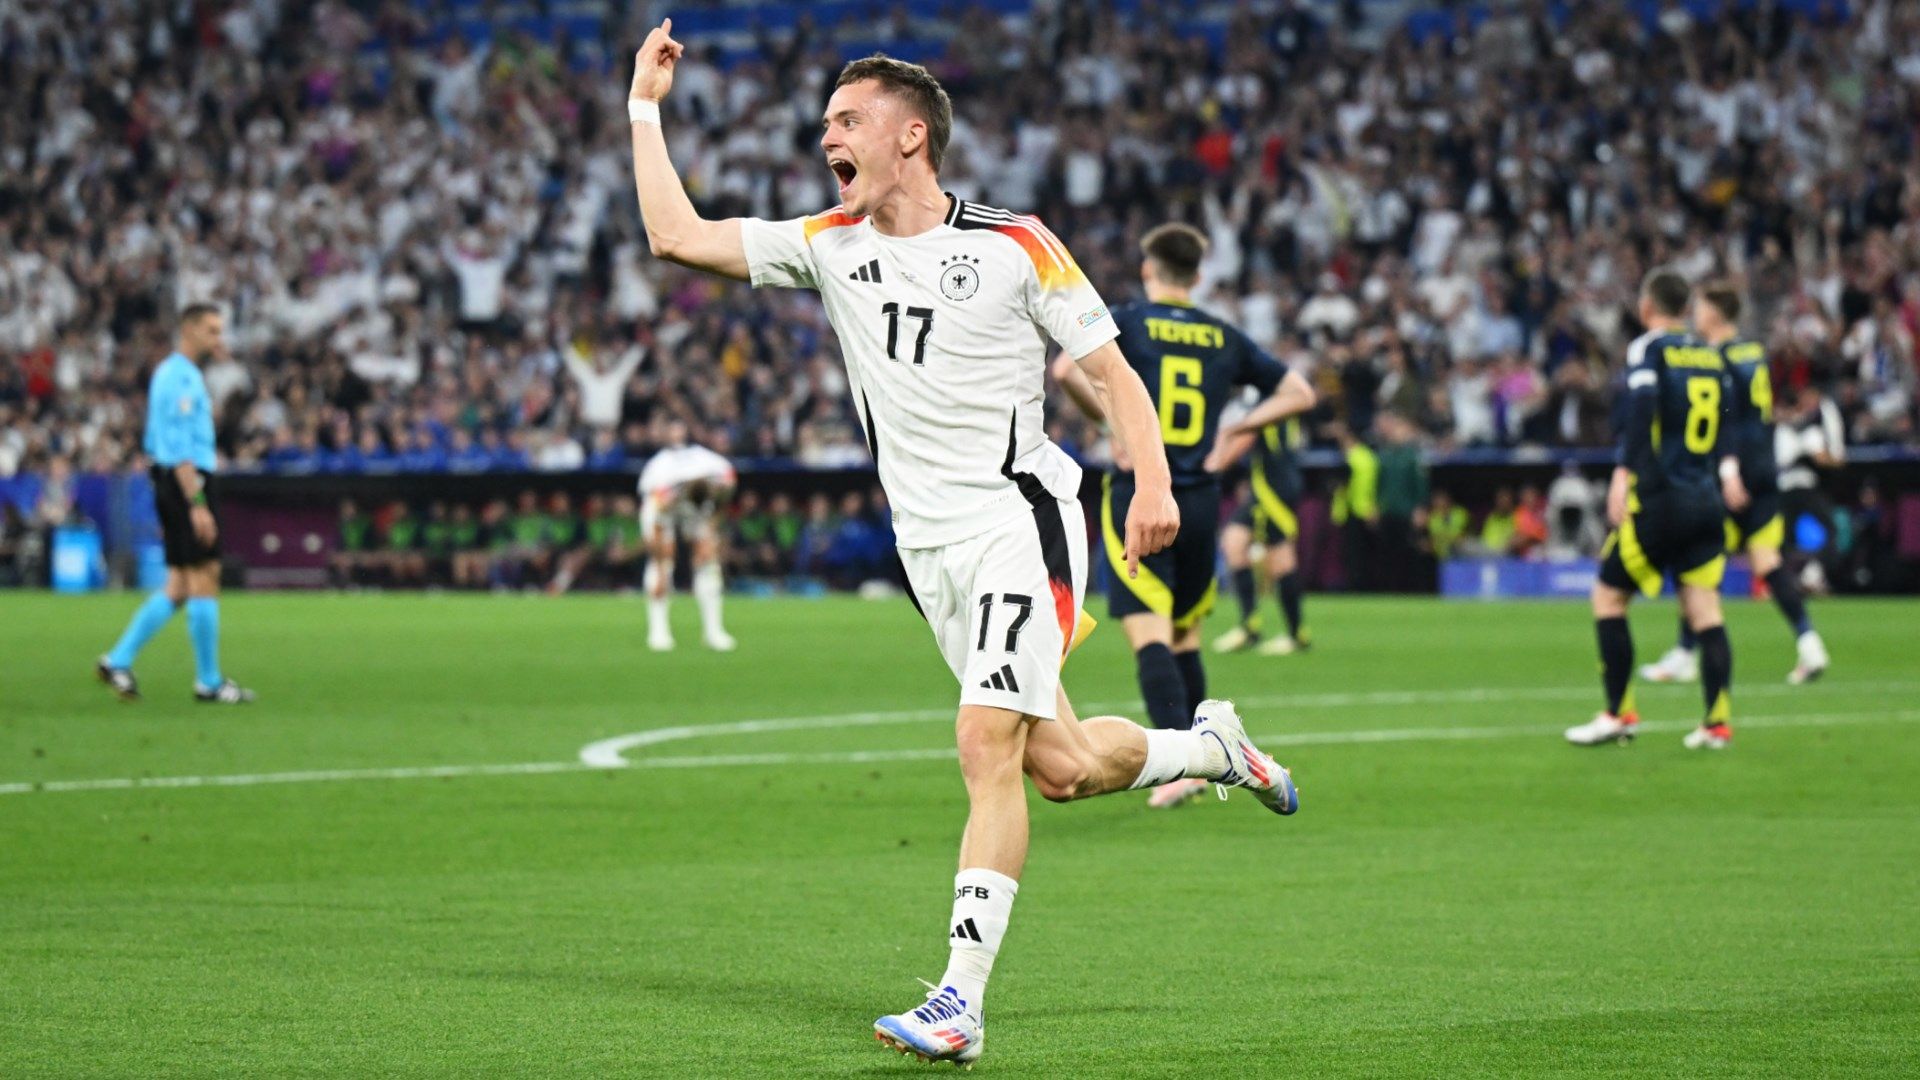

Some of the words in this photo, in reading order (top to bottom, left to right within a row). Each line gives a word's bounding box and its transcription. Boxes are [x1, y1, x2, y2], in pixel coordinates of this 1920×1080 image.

[882, 301, 935, 367] 17
[1160, 355, 1205, 446] 6
[1685, 376, 1720, 453] 8
[977, 592, 1034, 655] 17
